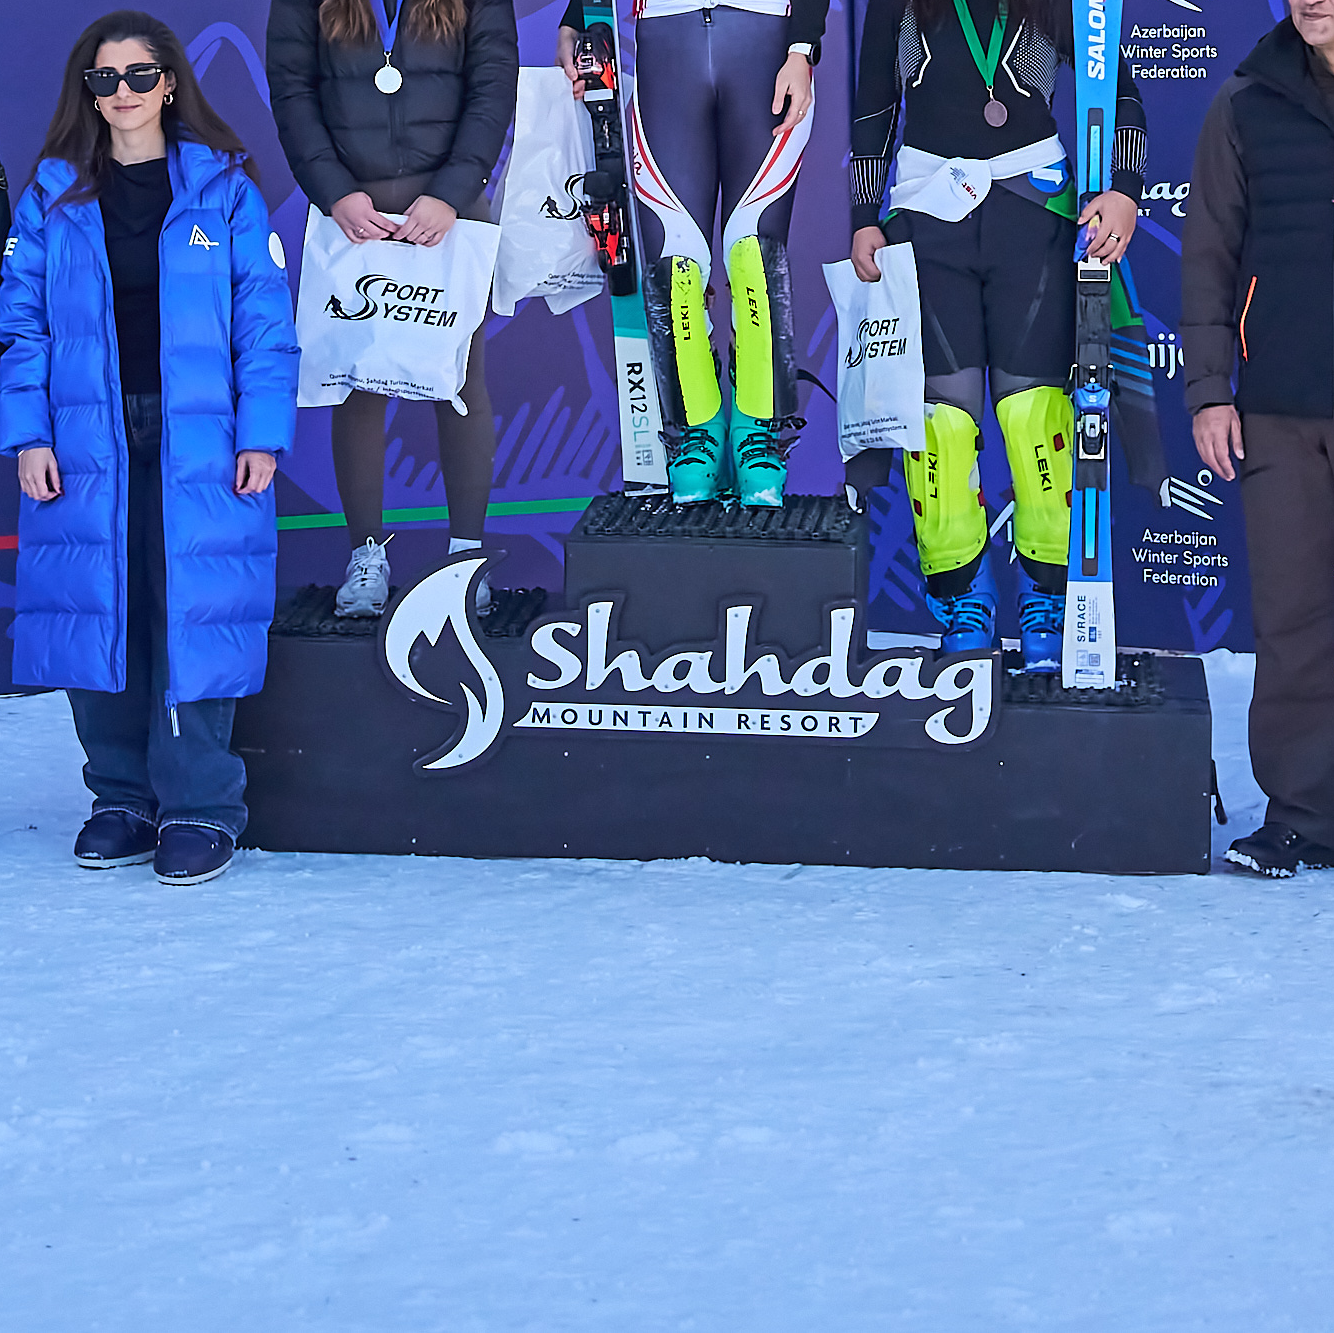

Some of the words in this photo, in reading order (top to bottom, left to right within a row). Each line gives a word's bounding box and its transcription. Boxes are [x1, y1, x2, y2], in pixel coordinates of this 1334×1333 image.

[1130, 23, 1206, 41] Azerbaijan
[1120, 44, 1168, 59] Winter
[1171, 43, 1218, 62] Sports
[1131, 64, 1207, 79] Federation
[746, 286, 760, 327] LEKI
[680, 305, 691, 341] LEKI
[1034, 444, 1053, 492] LEKI
[1142, 528, 1217, 549] Azerbaijan
[1132, 548, 1179, 564] Winter
[1183, 550, 1229, 568] Sports
[1143, 568, 1218, 587] Federation
[1076, 595, 1086, 643] S/RACE
[525, 601, 997, 745] Shahdag
[530, 705, 717, 731] MOUNTAIN
[735, 712, 865, 736] RESORT
